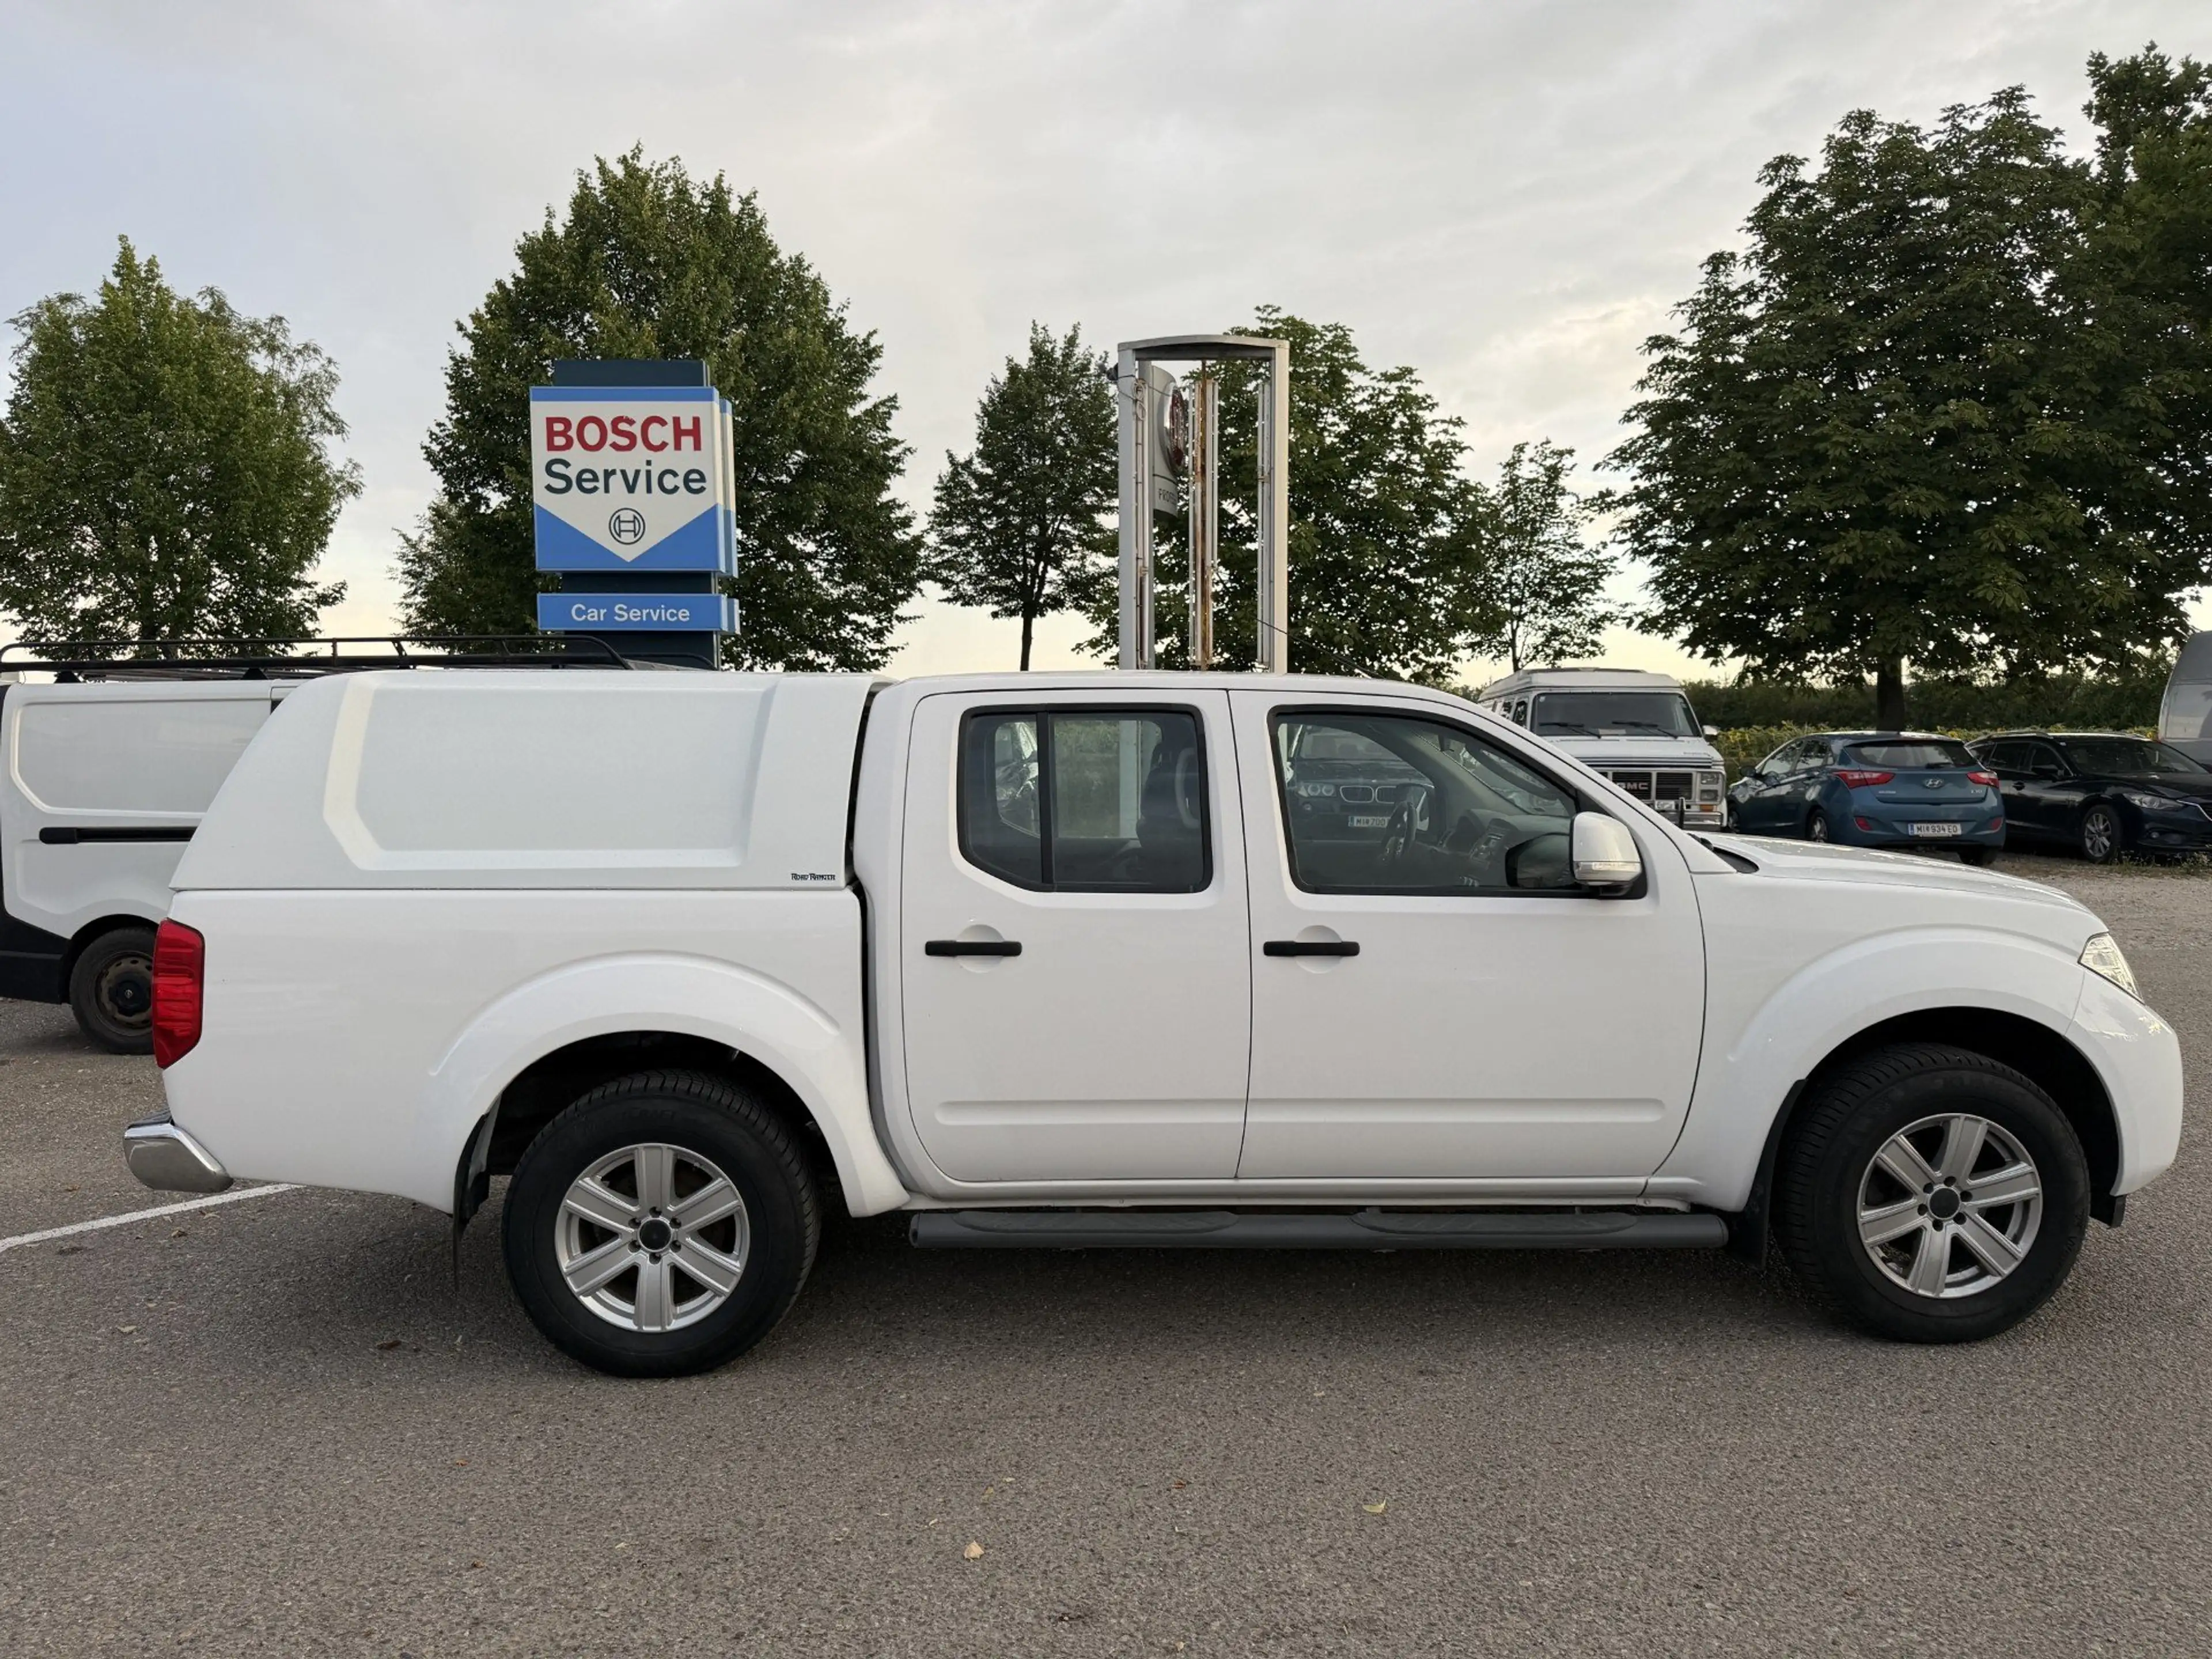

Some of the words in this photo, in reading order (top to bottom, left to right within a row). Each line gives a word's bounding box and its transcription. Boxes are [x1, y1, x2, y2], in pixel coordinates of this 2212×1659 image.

[546, 415, 702, 452] BOSCH
[544, 459, 707, 495] Service
[571, 604, 607, 622] Car
[614, 604, 690, 622] Service
[1917, 824, 1925, 832] MI
